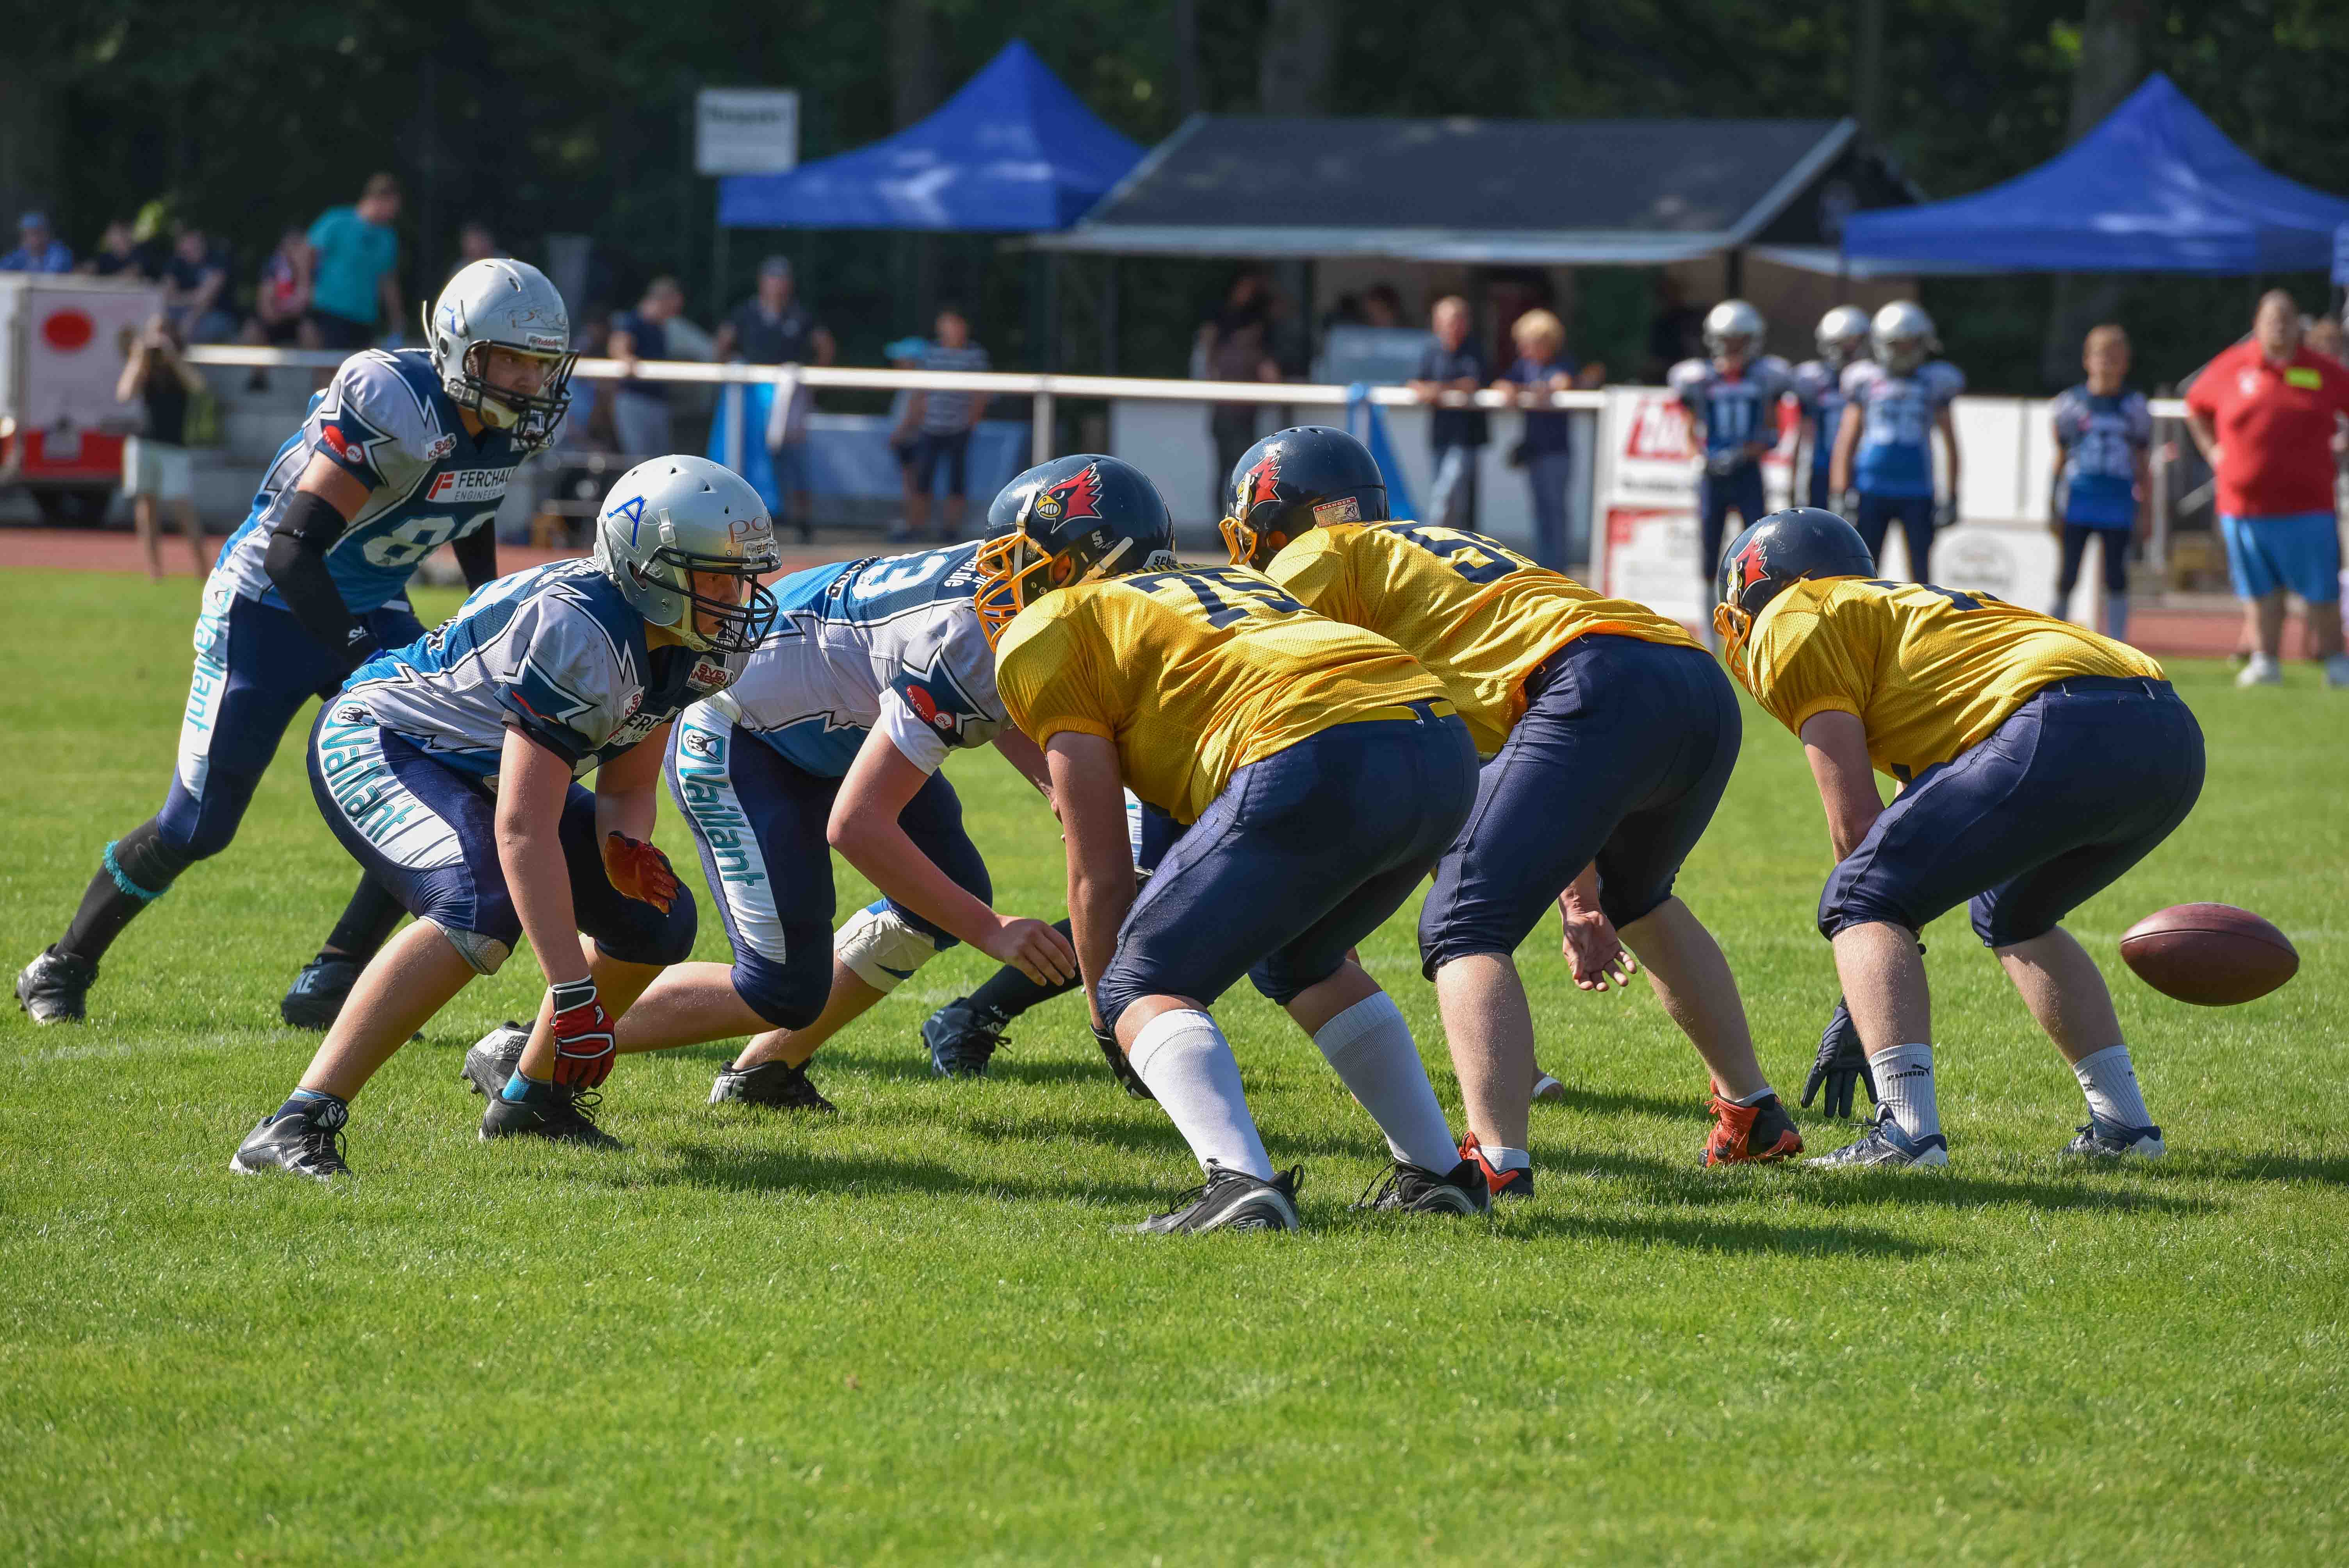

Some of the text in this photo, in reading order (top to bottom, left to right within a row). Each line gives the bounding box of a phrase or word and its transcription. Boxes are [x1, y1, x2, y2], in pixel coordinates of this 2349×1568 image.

[606, 495, 647, 553] A
[1322, 499, 1351, 510] DANGER
[1121, 567, 1310, 630] 75
[936, 715, 952, 726] 24
[321, 725, 416, 843] Vaillant
[679, 767, 765, 886] Vaillant
